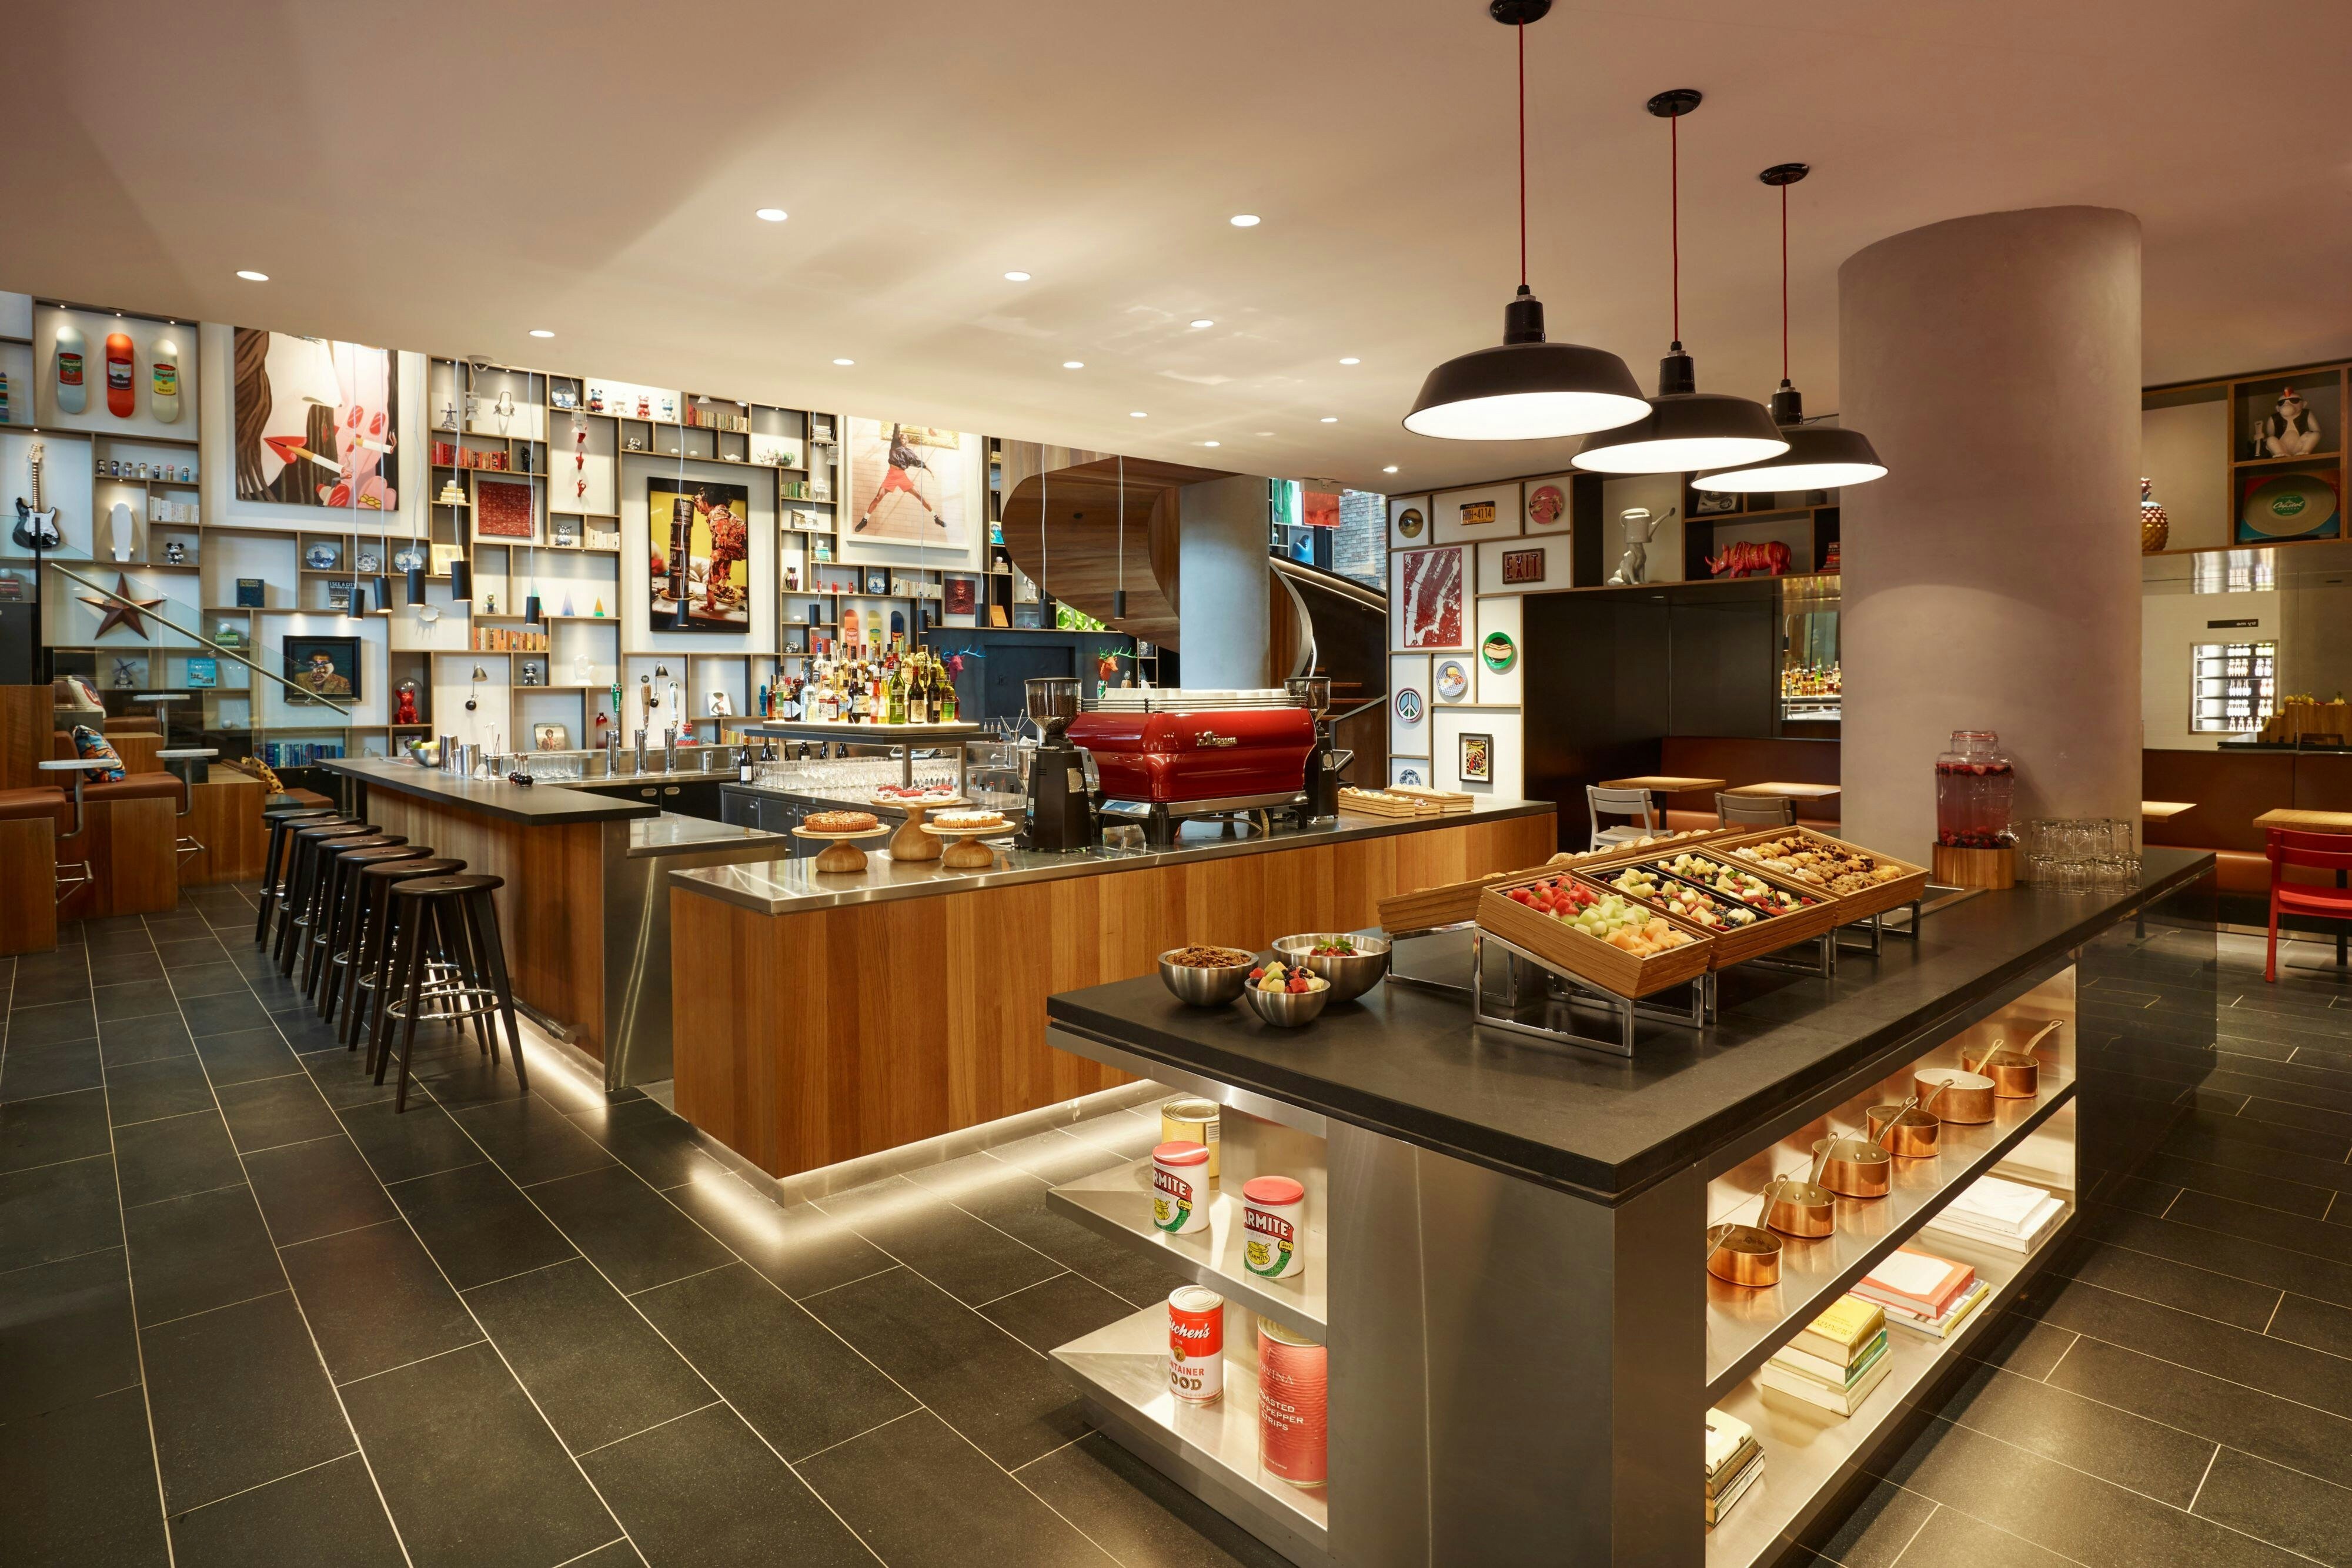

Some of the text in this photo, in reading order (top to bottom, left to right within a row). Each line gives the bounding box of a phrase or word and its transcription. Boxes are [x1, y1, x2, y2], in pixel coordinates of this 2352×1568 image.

[2273, 501, 2304, 509] Capitol
[1506, 554, 1538, 579] EXIT
[1154, 1170, 1187, 1196] RMITE
[1244, 1211, 1288, 1236] ARMITE
[1248, 1249, 1268, 1261] MARMITE
[1170, 1359, 1204, 1376] NTAINER
[1259, 1359, 1294, 1385] DIVINA
[1170, 1369, 1202, 1391] OOD
[1259, 1387, 1295, 1413] ROASTED
[1261, 1410, 1289, 1431] STRIPS
[1267, 1405, 1304, 1424] PEPPER
